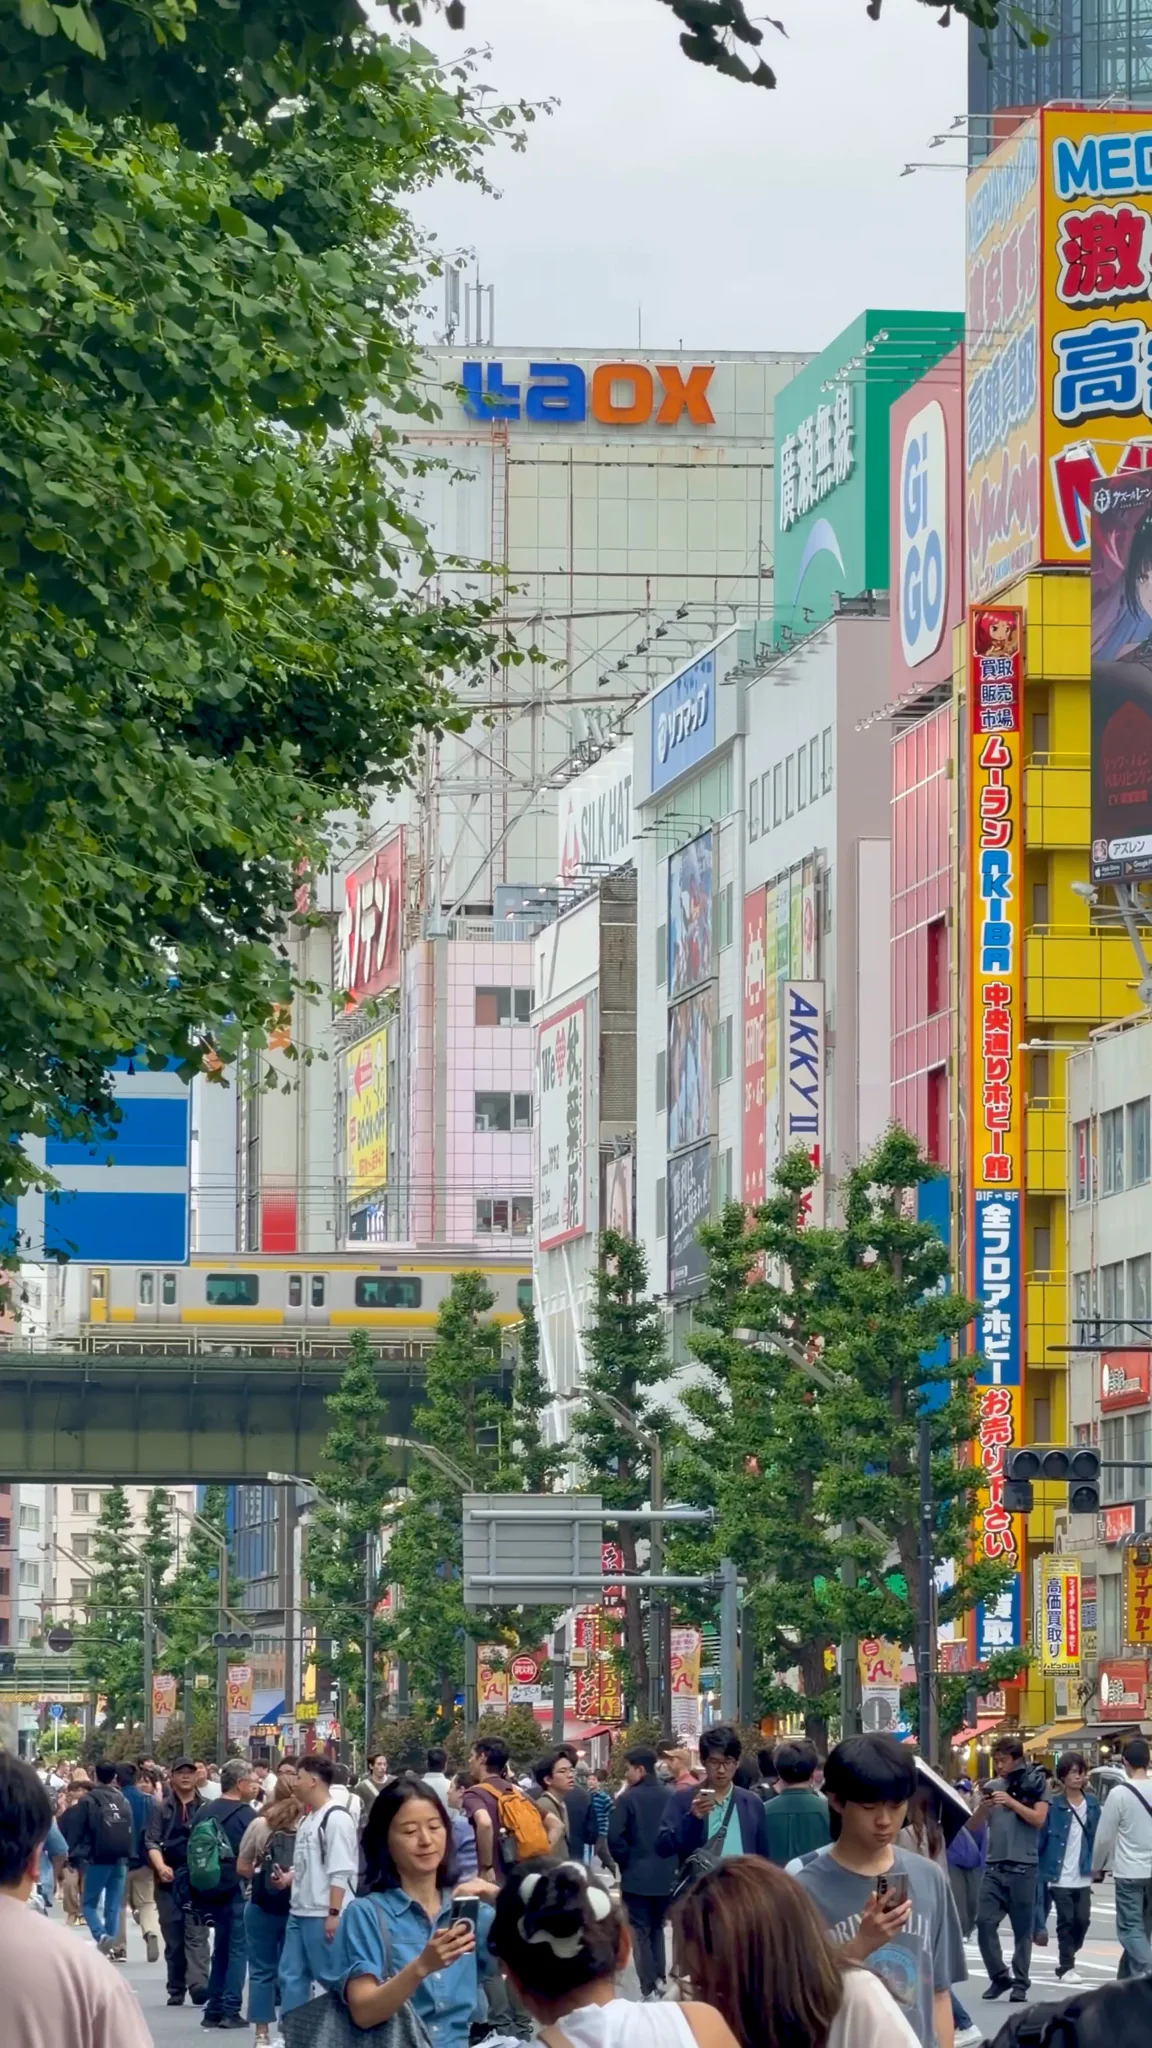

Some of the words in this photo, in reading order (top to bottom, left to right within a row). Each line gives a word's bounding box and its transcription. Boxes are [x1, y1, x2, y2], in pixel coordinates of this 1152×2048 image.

[980, 658, 1013, 679] 買取
[980, 684, 1013, 704] 販売
[980, 709, 1013, 730] 市場
[581, 790, 606, 875] SILK
[609, 774, 632, 857] HAT
[1112, 841, 1146, 861] アズレン
[790, 988, 819, 1110] AKKY
[983, 982, 1012, 1182] 中央通りホビー館
[982, 1203, 1012, 1385] 全フロアホビー
[1046, 1577, 1063, 1658] 高価買取り
